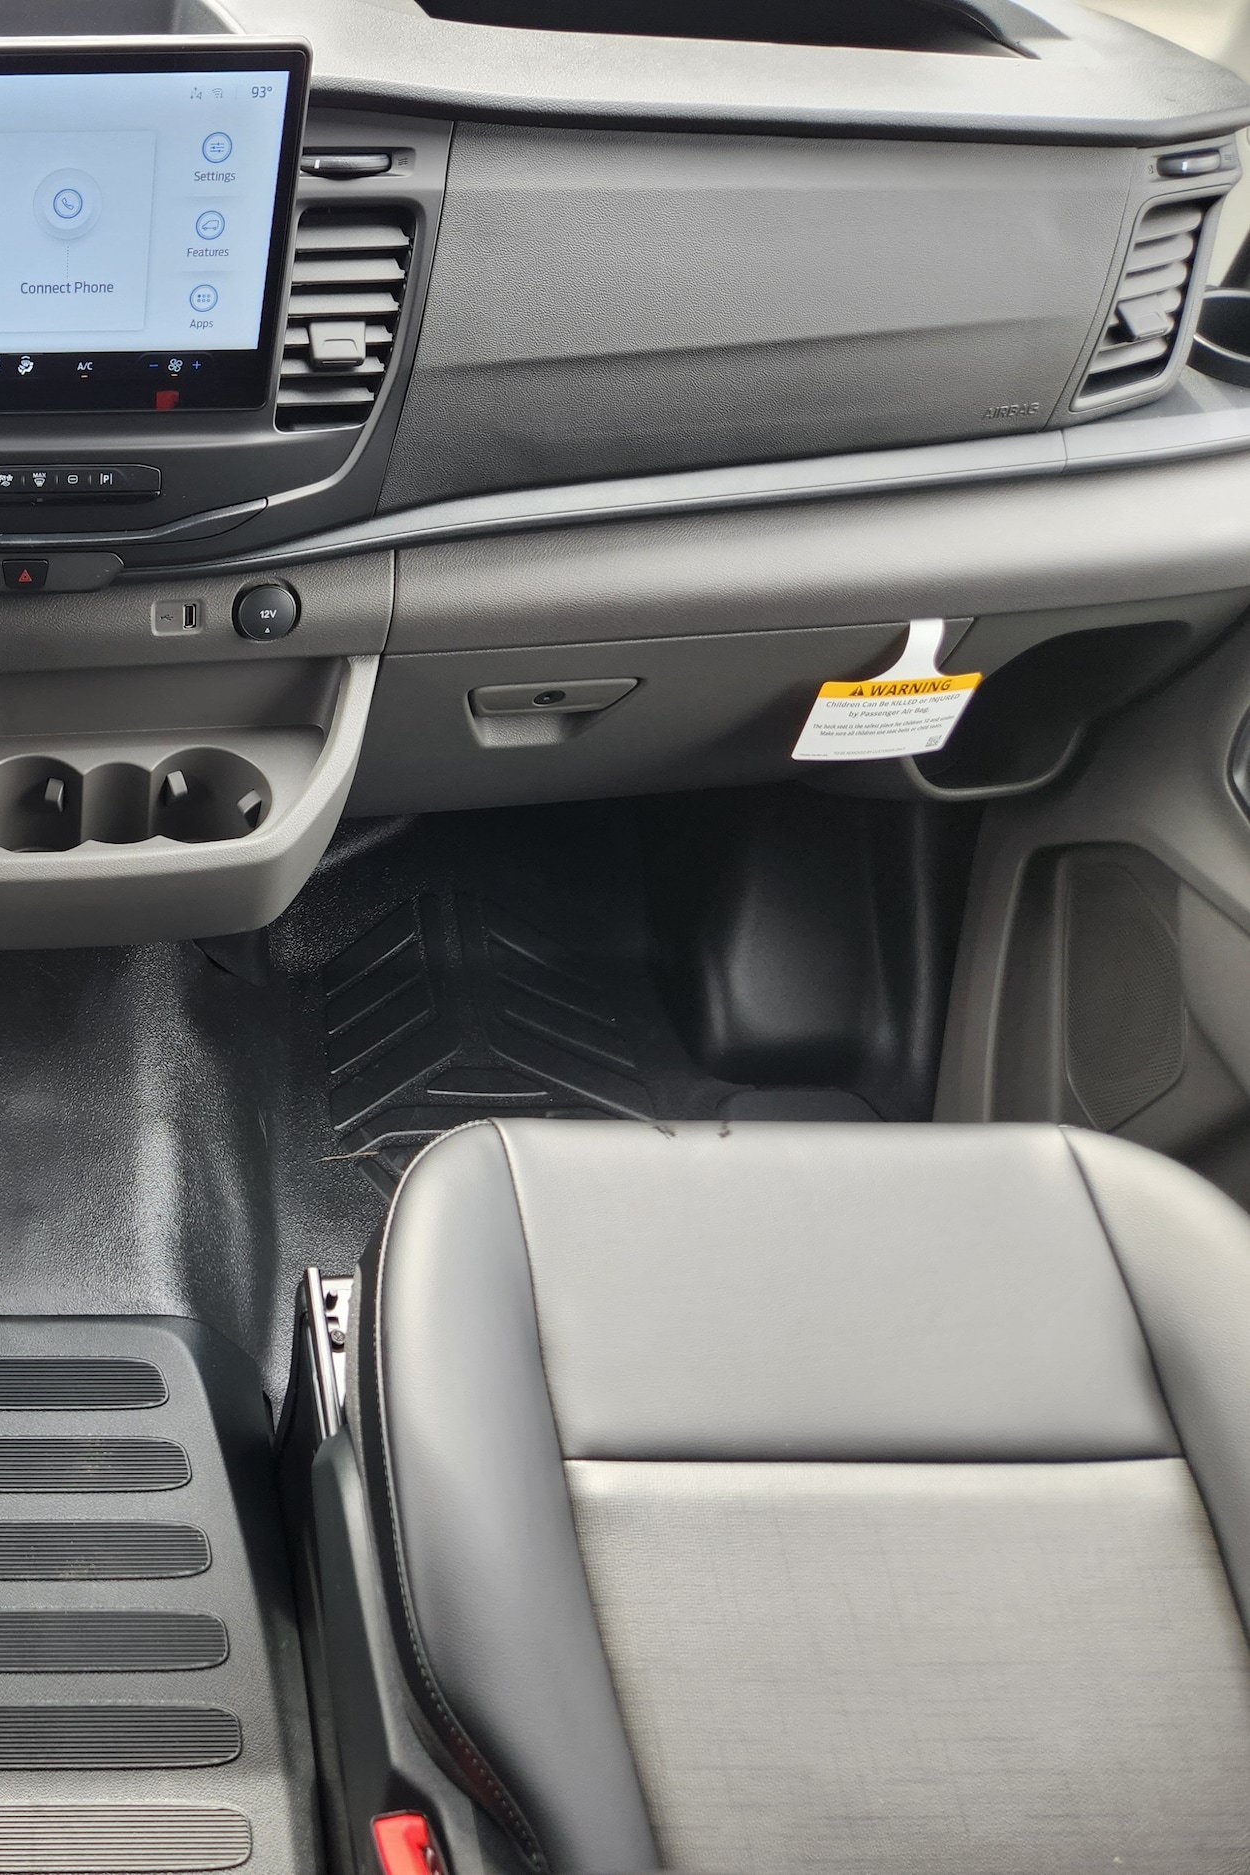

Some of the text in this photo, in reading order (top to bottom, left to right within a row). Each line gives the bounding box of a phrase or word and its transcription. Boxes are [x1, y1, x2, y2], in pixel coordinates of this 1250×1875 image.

[251, 86, 273, 98] 93°
[194, 171, 236, 182] Settings
[187, 247, 229, 257] Features
[20, 281, 114, 294] Connect Phone
[190, 319, 214, 328] Apps
[77, 361, 93, 371] A/C
[260, 609, 277, 619] 12V
[870, 679, 952, 697] WARNING
[928, 694, 961, 704] INJURED
[848, 711, 858, 719] by
[860, 709, 900, 718] Passenger
